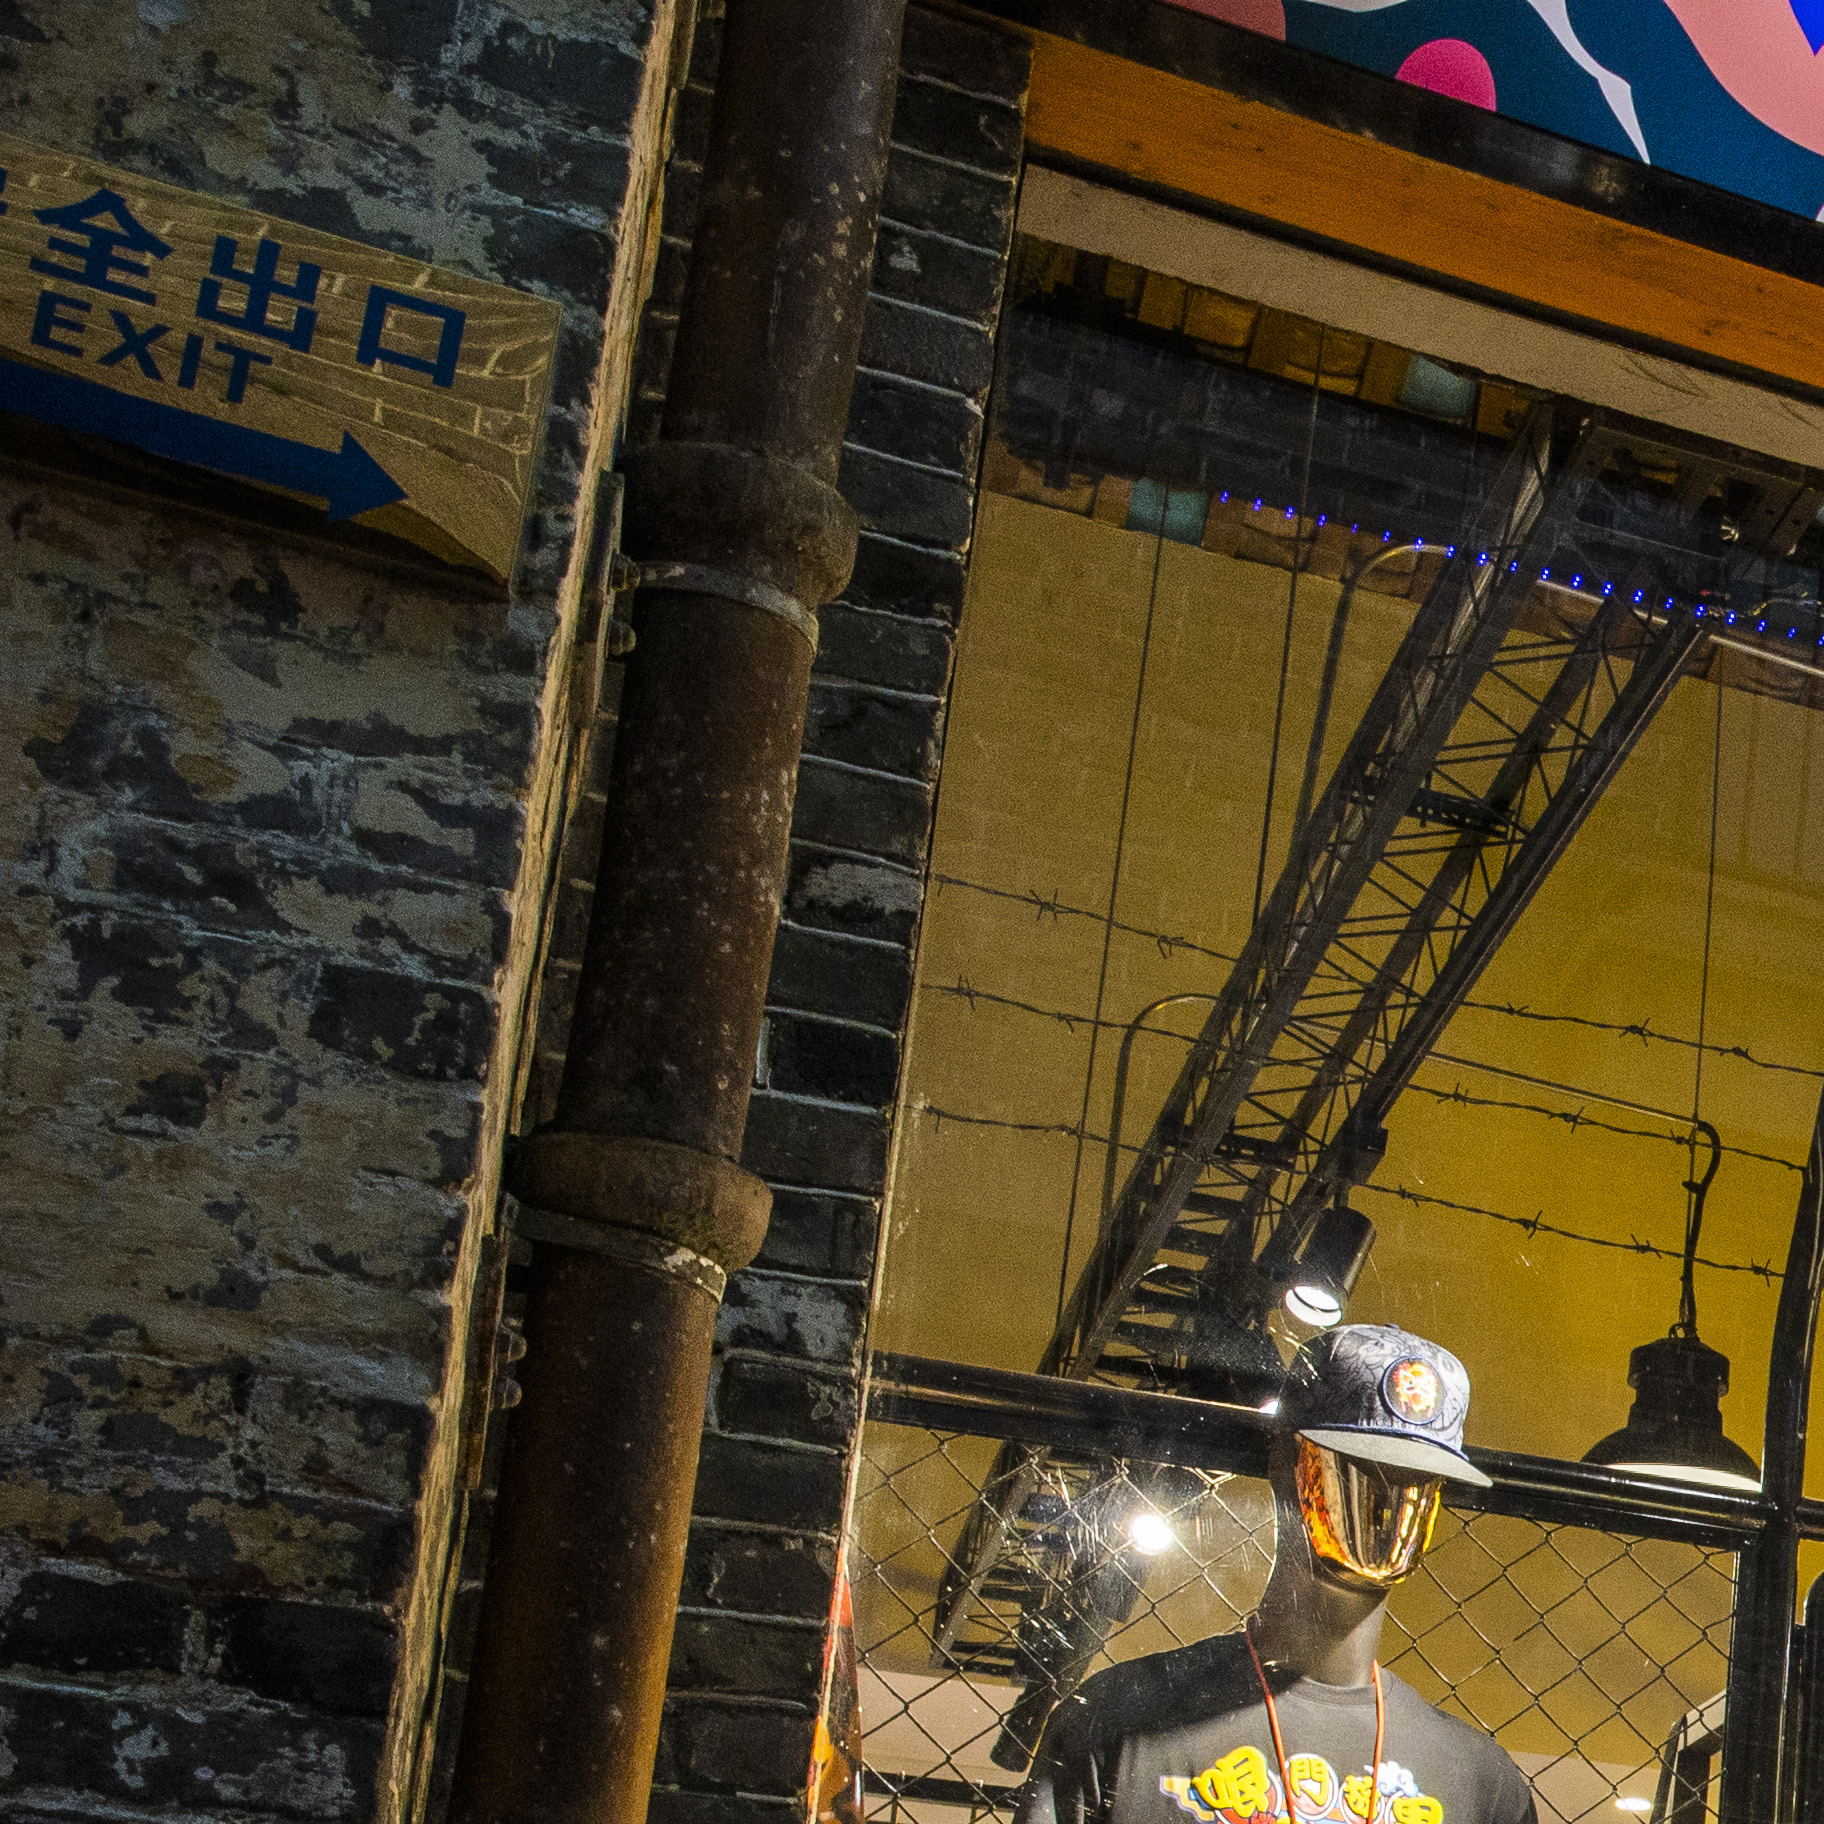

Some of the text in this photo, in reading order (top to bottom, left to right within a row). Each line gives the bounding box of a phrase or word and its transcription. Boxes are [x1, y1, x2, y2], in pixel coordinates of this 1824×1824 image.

[0, 168, 466, 388] 全出口
[30, 290, 272, 403] EXIT
